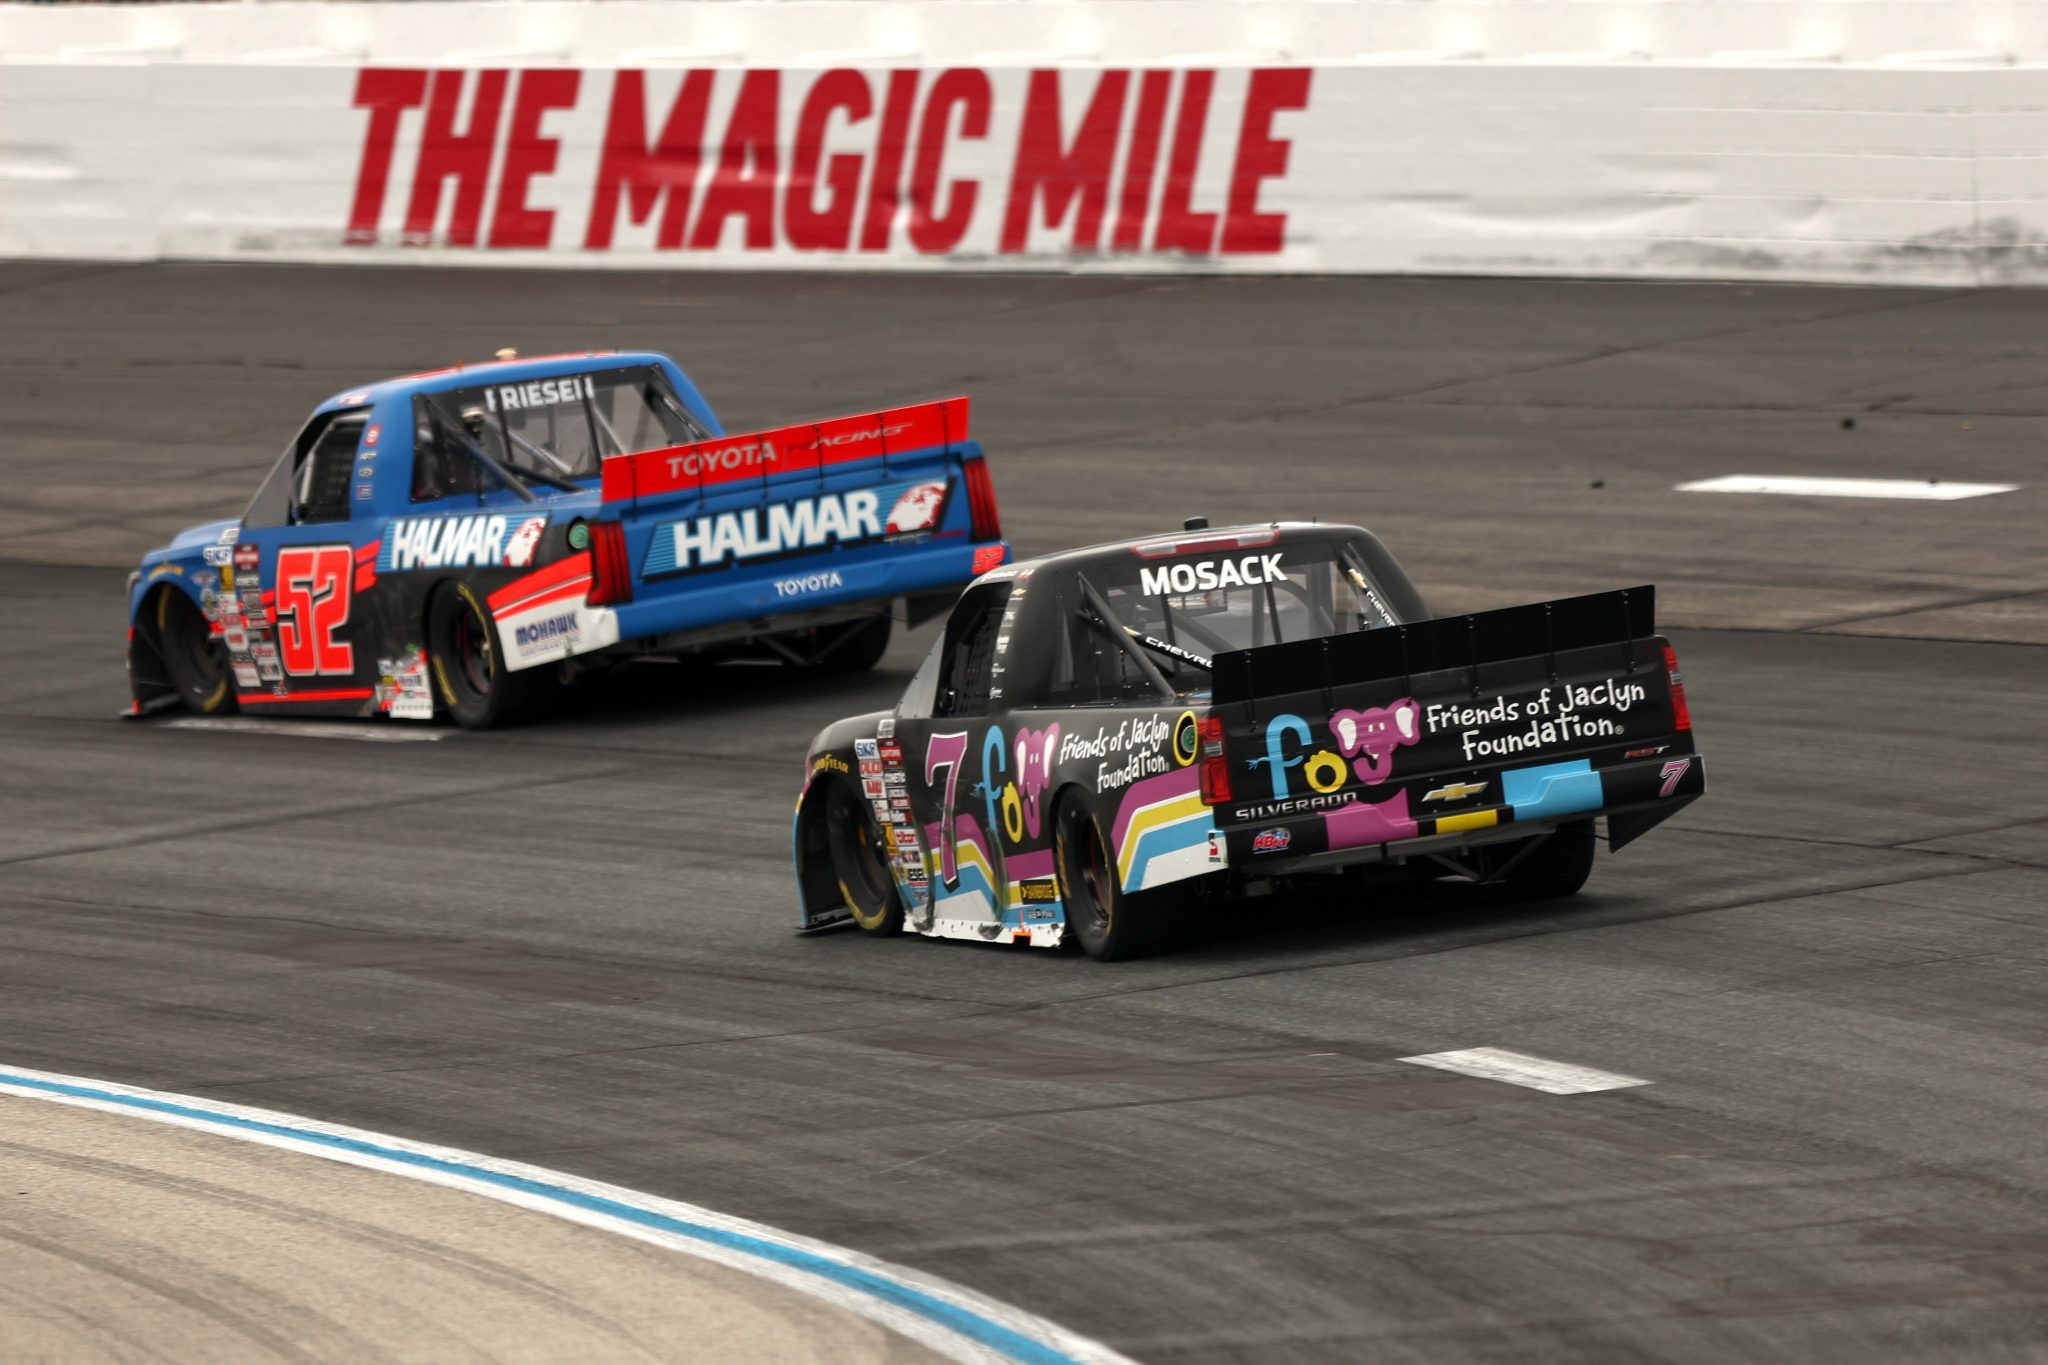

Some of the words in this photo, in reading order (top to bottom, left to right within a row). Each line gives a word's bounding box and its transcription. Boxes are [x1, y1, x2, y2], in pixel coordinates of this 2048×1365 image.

[342, 68, 583, 249] THE
[583, 68, 993, 253] MAGIC
[997, 67, 1313, 255] MILE
[666, 441, 776, 479] TOYOTA
[391, 514, 507, 570] HALMAR
[672, 490, 881, 568] HALMAR
[774, 571, 842, 598] TOYOTA
[1140, 553, 1288, 597] MOSACK
[275, 544, 354, 676] 52
[515, 611, 578, 647] MOHAWK
[1427, 696, 1519, 733] Friends
[1526, 688, 1551, 715] of
[1558, 678, 1645, 712] Jaclyn
[1058, 727, 1109, 765] Friends
[1109, 721, 1128, 752] of
[1125, 713, 1169, 753] Jaclyn
[1097, 746, 1166, 794] Foundation
[1659, 758, 1690, 798] 7
[925, 731, 968, 886] 7
[1236, 792, 1356, 821] SILVERADO
